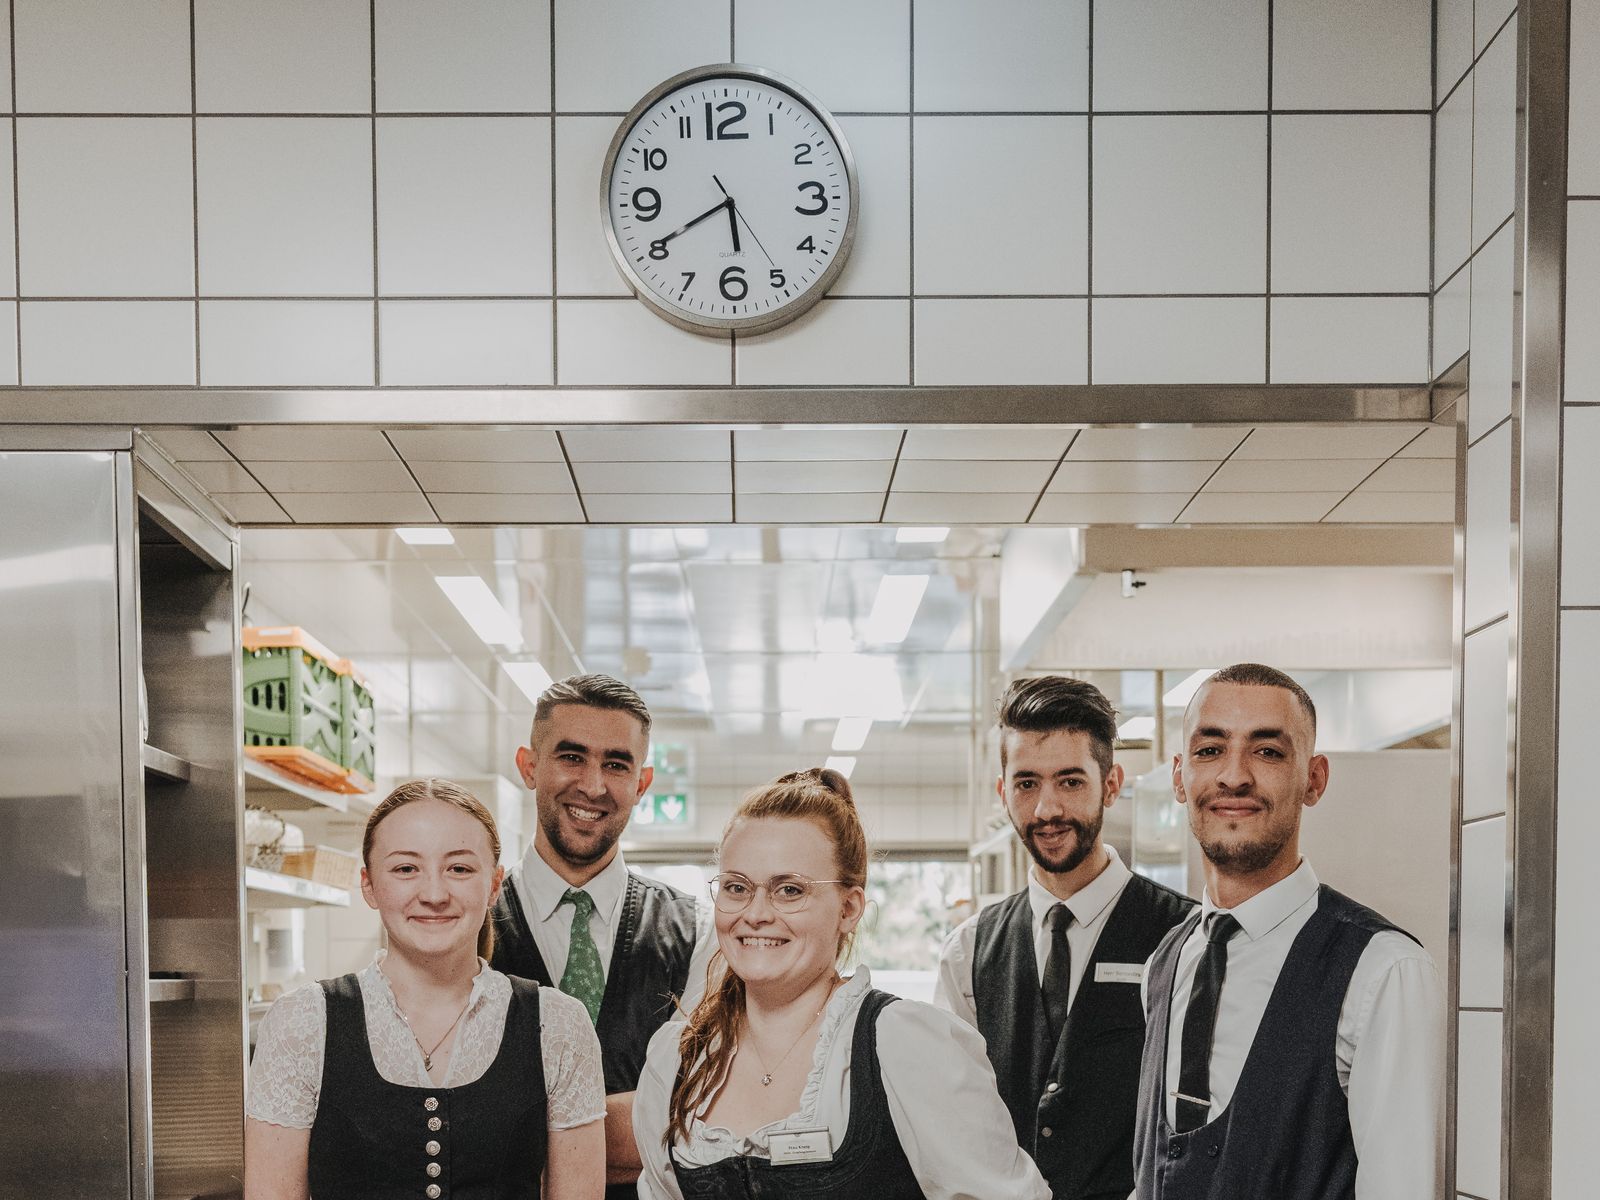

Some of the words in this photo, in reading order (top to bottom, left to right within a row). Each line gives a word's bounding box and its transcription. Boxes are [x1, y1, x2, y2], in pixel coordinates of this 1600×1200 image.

[679, 115, 692, 139] 11
[704, 101, 749, 141] 12
[768, 112, 774, 136] 1
[643, 147, 668, 172] 10
[794, 143, 813, 165] 2
[631, 186, 662, 222] 9
[794, 180, 829, 216] 3
[648, 239, 670, 261] 8
[796, 235, 816, 254] 4
[681, 271, 696, 292] 7
[719, 265, 748, 302] 6
[769, 268, 786, 288] 5
